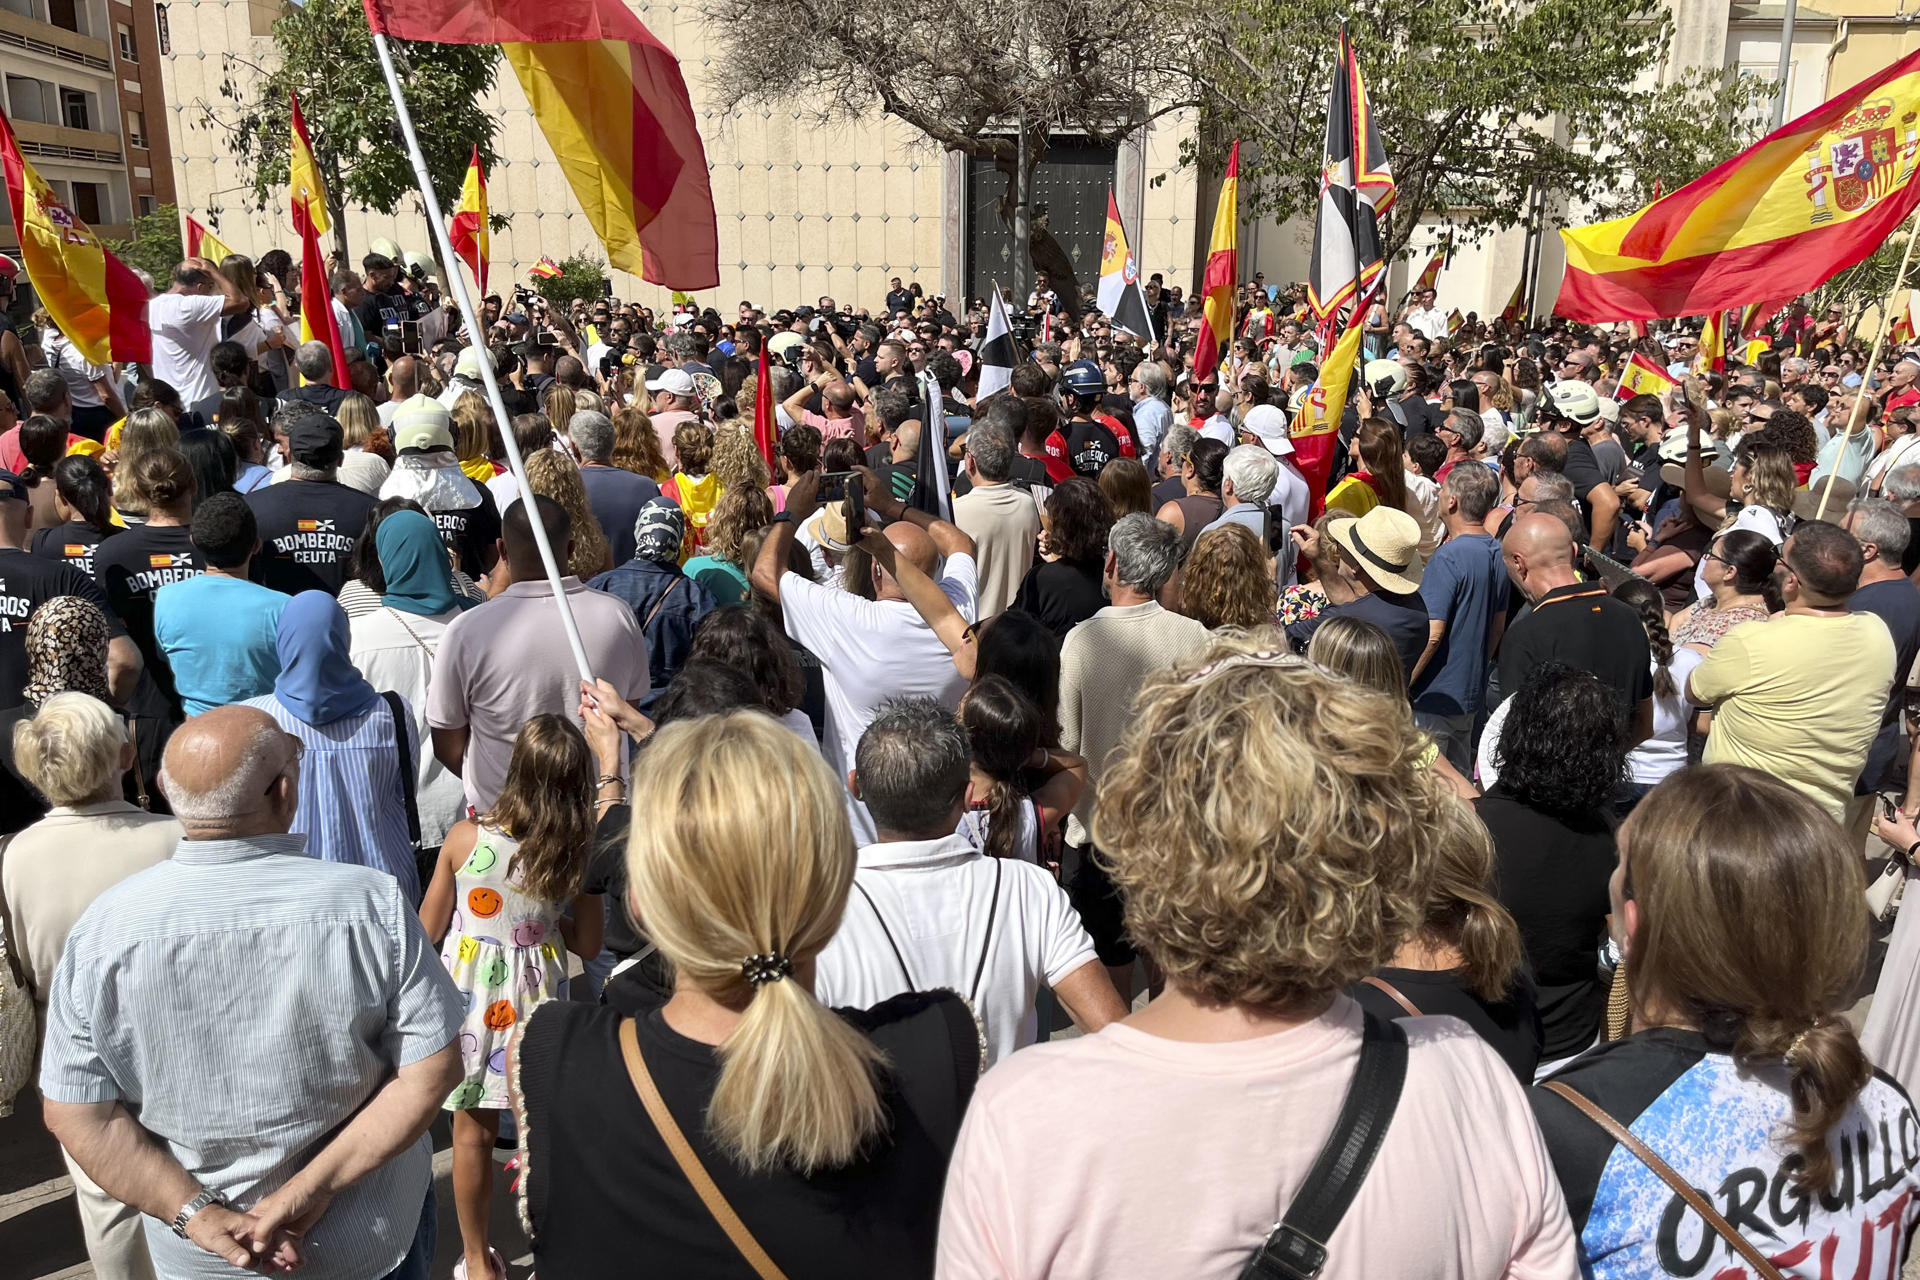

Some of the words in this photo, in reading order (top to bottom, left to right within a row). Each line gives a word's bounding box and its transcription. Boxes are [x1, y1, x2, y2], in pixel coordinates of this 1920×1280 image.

[273, 532, 355, 553] BOMBEROS
[294, 551, 336, 564] CEUTA
[1656, 1106, 1918, 1278] ORGULLO
